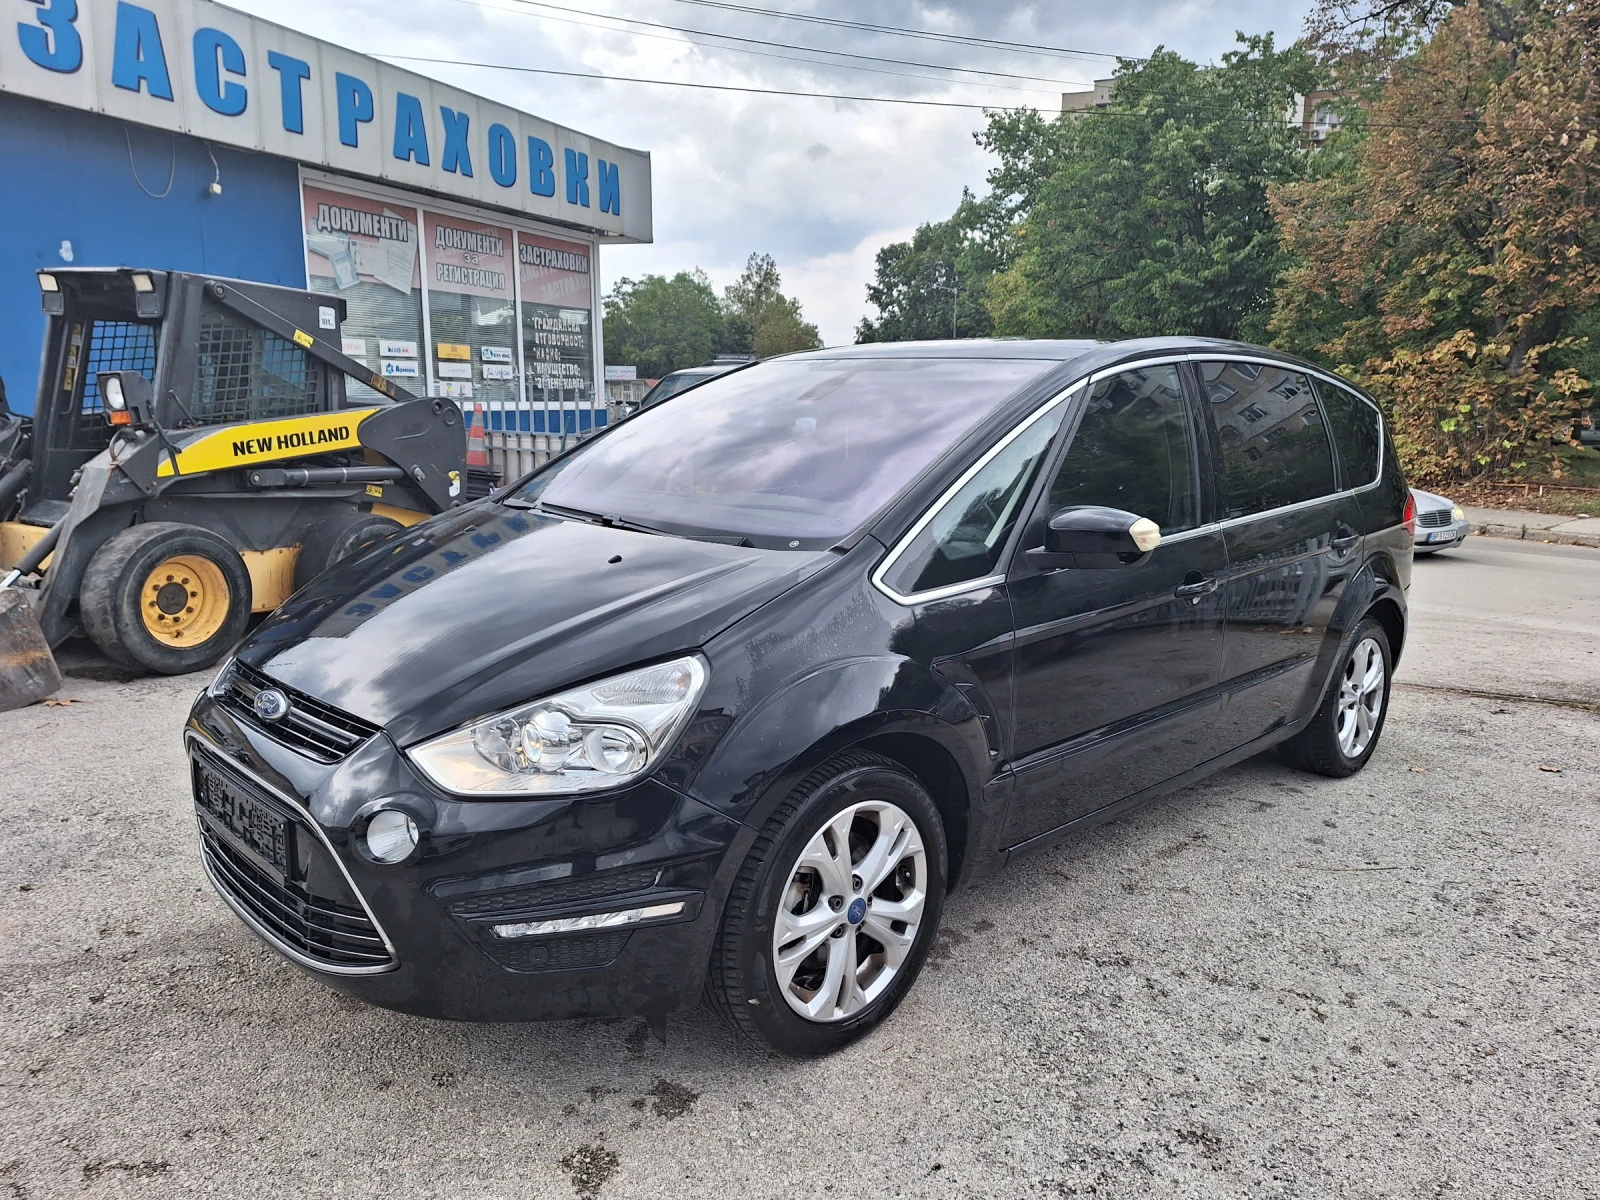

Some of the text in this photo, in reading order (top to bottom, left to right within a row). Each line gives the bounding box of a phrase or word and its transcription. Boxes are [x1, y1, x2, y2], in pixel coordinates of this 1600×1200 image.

[17, 0, 622, 217] ЗАСТРАХОВКИ
[316, 203, 409, 242] ДОКУМЕНТИ
[435, 225, 504, 257] ДОКУМЕНТИ
[463, 252, 479, 265] за
[519, 243, 588, 274] ЗАСТРАХОВКИ
[436, 262, 506, 291] РЕГИСТРАЦИЯ
[232, 425, 350, 457] NEW HOLLAND
